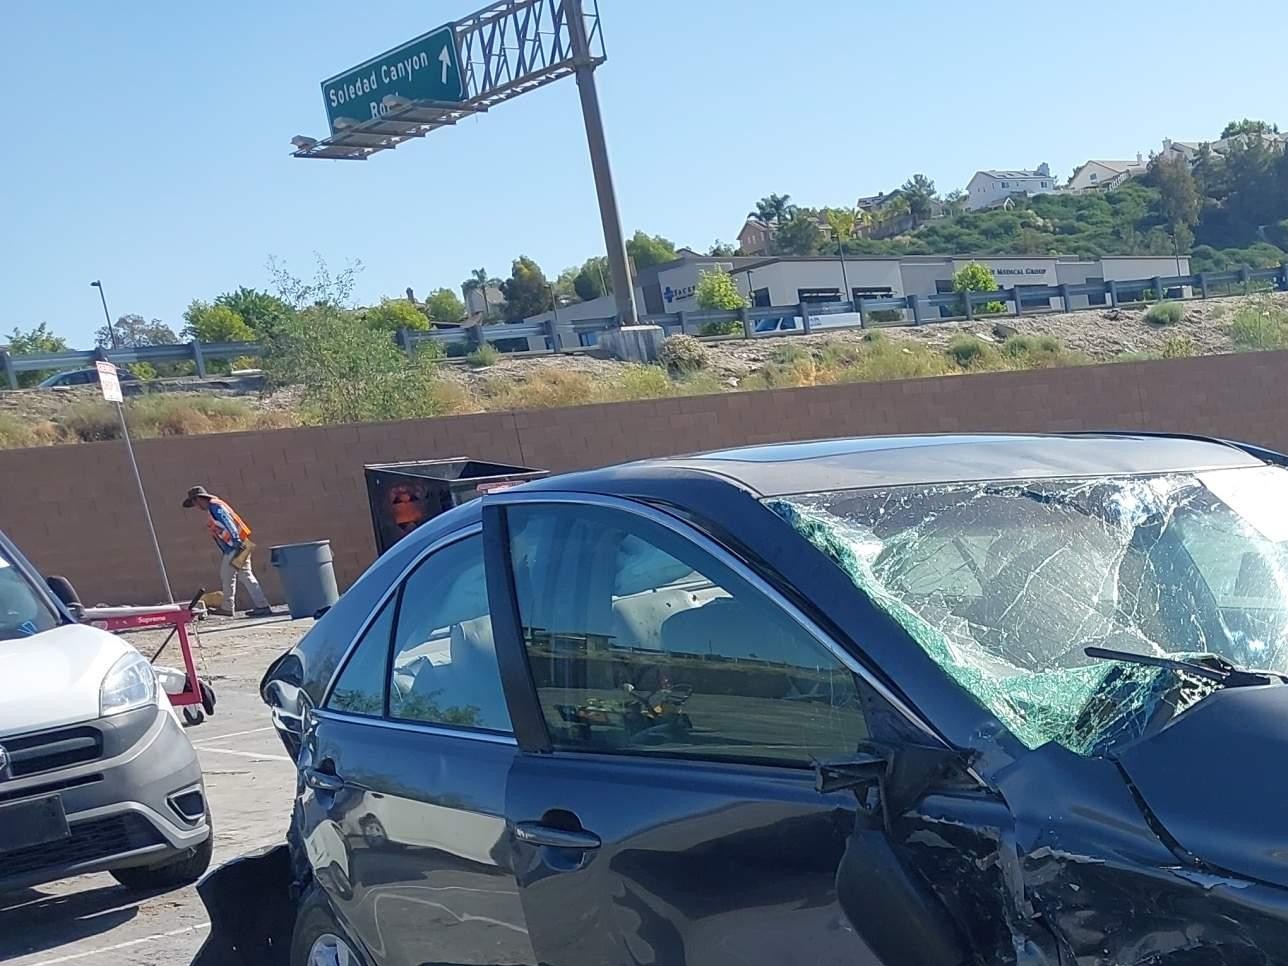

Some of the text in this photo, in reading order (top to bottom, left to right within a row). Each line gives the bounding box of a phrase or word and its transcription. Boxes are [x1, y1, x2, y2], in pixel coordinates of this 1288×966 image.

[329, 51, 428, 107] Soledad Canyon
[369, 91, 400, 120] Ro
